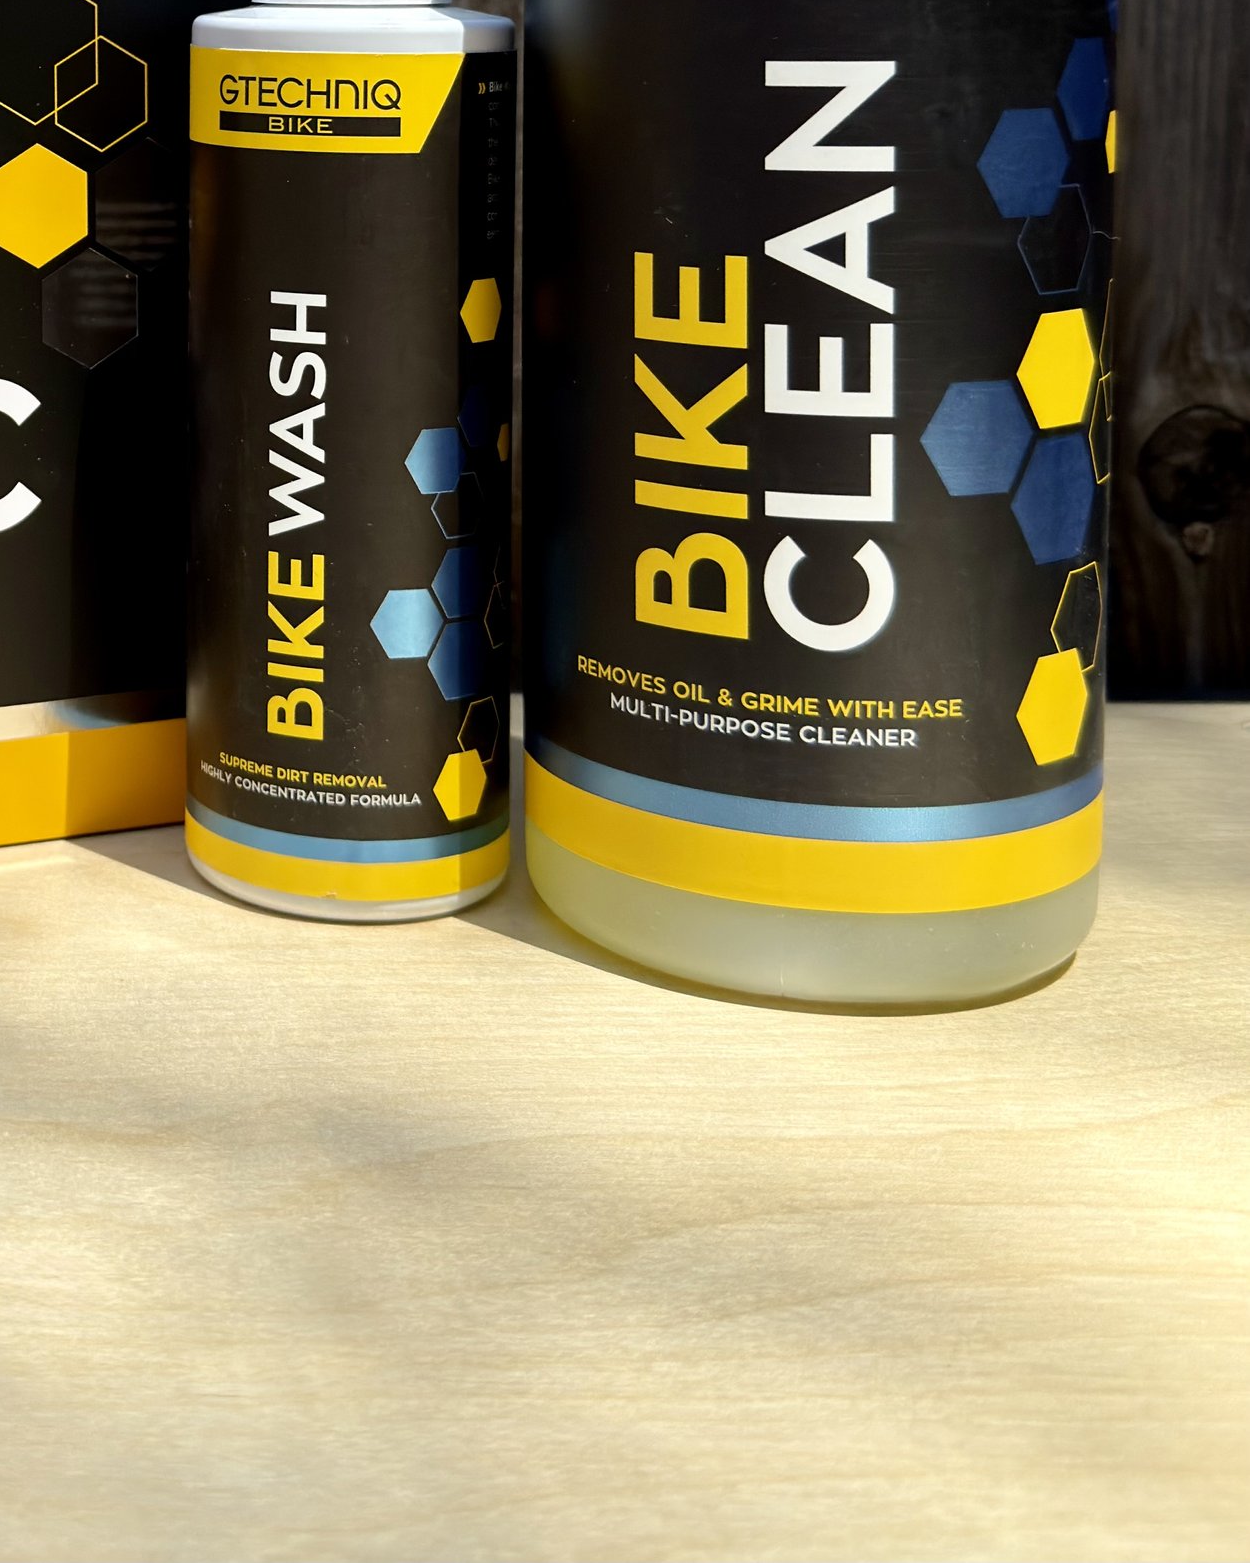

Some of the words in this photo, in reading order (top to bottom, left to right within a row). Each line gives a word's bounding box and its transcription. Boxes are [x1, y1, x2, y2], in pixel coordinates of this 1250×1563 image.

[220, 74, 402, 110] GTECHNIQ
[268, 116, 333, 134] BIKE
[763, 60, 897, 653] CLEAN
[268, 290, 327, 537] WASH
[634, 251, 749, 640] BIKE
[267, 550, 325, 741] BIKE
[577, 654, 666, 695] REMOVES
[673, 680, 710, 704] OIL
[717, 688, 733, 706] &
[741, 691, 819, 717] GRIME
[827, 698, 894, 719] WITH
[902, 698, 963, 719] EASE
[610, 691, 791, 741] MULTI-PURPOSE
[799, 725, 917, 748] CLEANER
[201, 760, 232, 784] HIGHLY
[234, 775, 346, 805] CONCENTRATED
[350, 792, 421, 807] FORMULA
[219, 751, 273, 777] SUPREME
[276, 767, 309, 783] DIRT
[313, 772, 387, 788] REMOVAL
